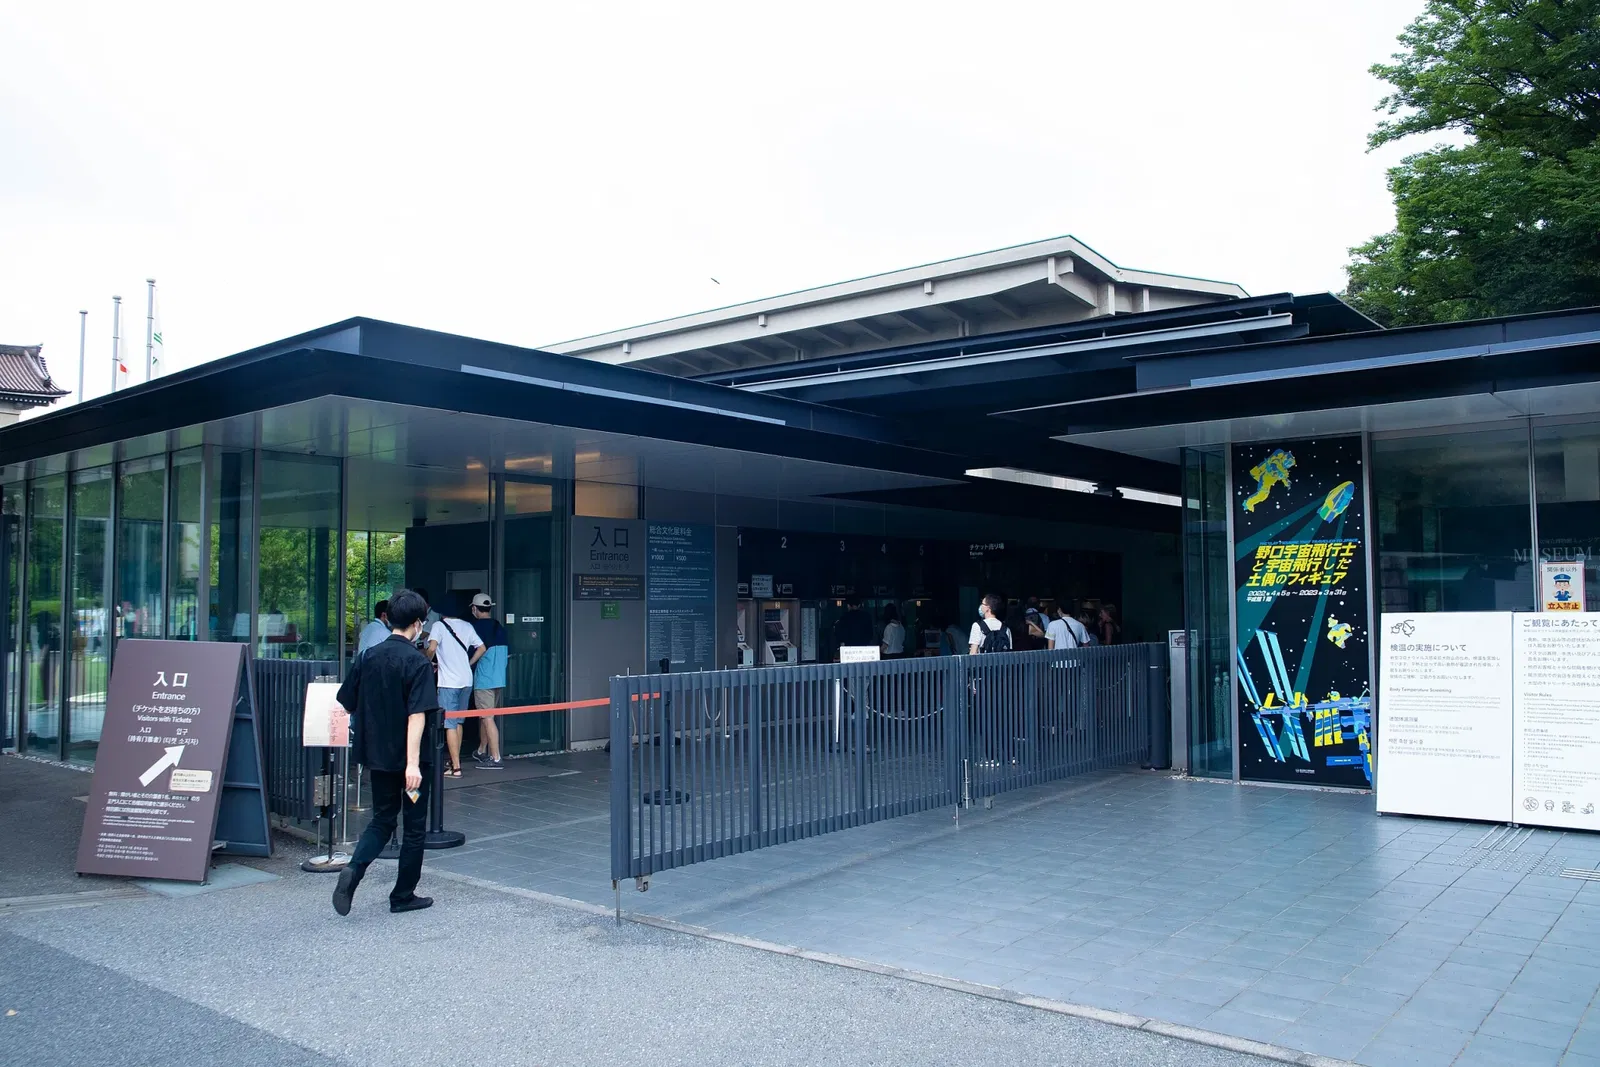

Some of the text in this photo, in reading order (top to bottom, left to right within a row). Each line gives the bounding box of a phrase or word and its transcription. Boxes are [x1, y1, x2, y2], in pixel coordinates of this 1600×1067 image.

[591, 526, 629, 549] 入口
[737, 534, 742, 547] 1
[781, 536, 787, 549] 2
[839, 540, 845, 552] 3
[880, 543, 886, 554] 4
[969, 543, 1005, 551] チケット売り場
[1255, 542, 1356, 559] 野口宇宙飛行士
[590, 549, 629, 562] Entrance
[1513, 546, 1592, 562] MSEUM
[1252, 557, 1349, 573] と宇宙飛行した
[1246, 571, 1347, 587] 土偶のフィギュア
[1548, 602, 1580, 610] 立入禁止
[1523, 618, 1599, 628] ご観覧にあたって
[1390, 643, 1467, 652] 検温の実施について
[153, 671, 189, 690] 入口
[152, 691, 186, 701] Entrance
[137, 715, 158, 723] Visitors
[139, 726, 152, 734] 入口
